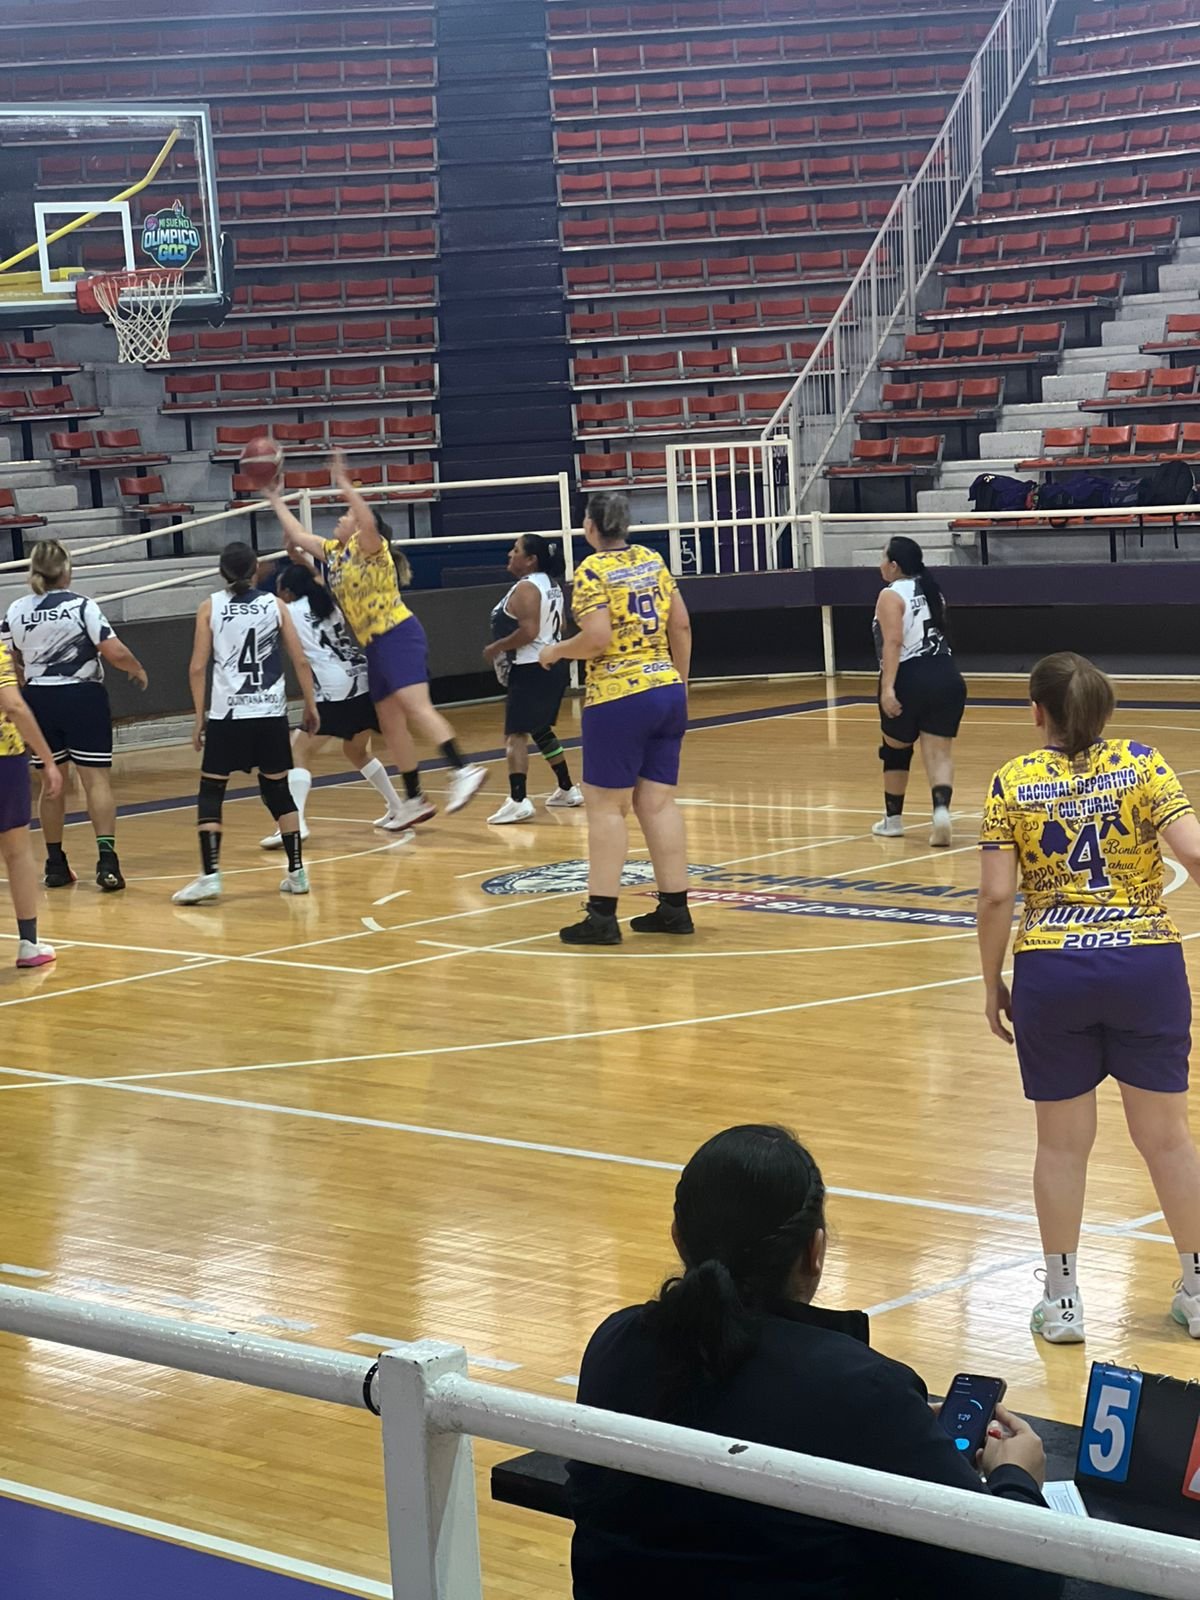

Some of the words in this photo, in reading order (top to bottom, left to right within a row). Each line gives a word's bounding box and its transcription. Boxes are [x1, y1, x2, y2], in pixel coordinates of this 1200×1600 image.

[21, 608, 72, 624] LUISA
[221, 604, 270, 616] JESSY
[637, 593, 660, 635] 9
[238, 627, 261, 684] 4
[1017, 781, 1073, 802] NACIONAL
[1075, 768, 1137, 797] DEPORTIVO
[1045, 803, 1054, 821] Y
[1058, 794, 1118, 819] CULTURAL
[1068, 823, 1112, 889] 4
[1063, 931, 1132, 949] 2025
[1089, 1384, 1131, 1473] 5
